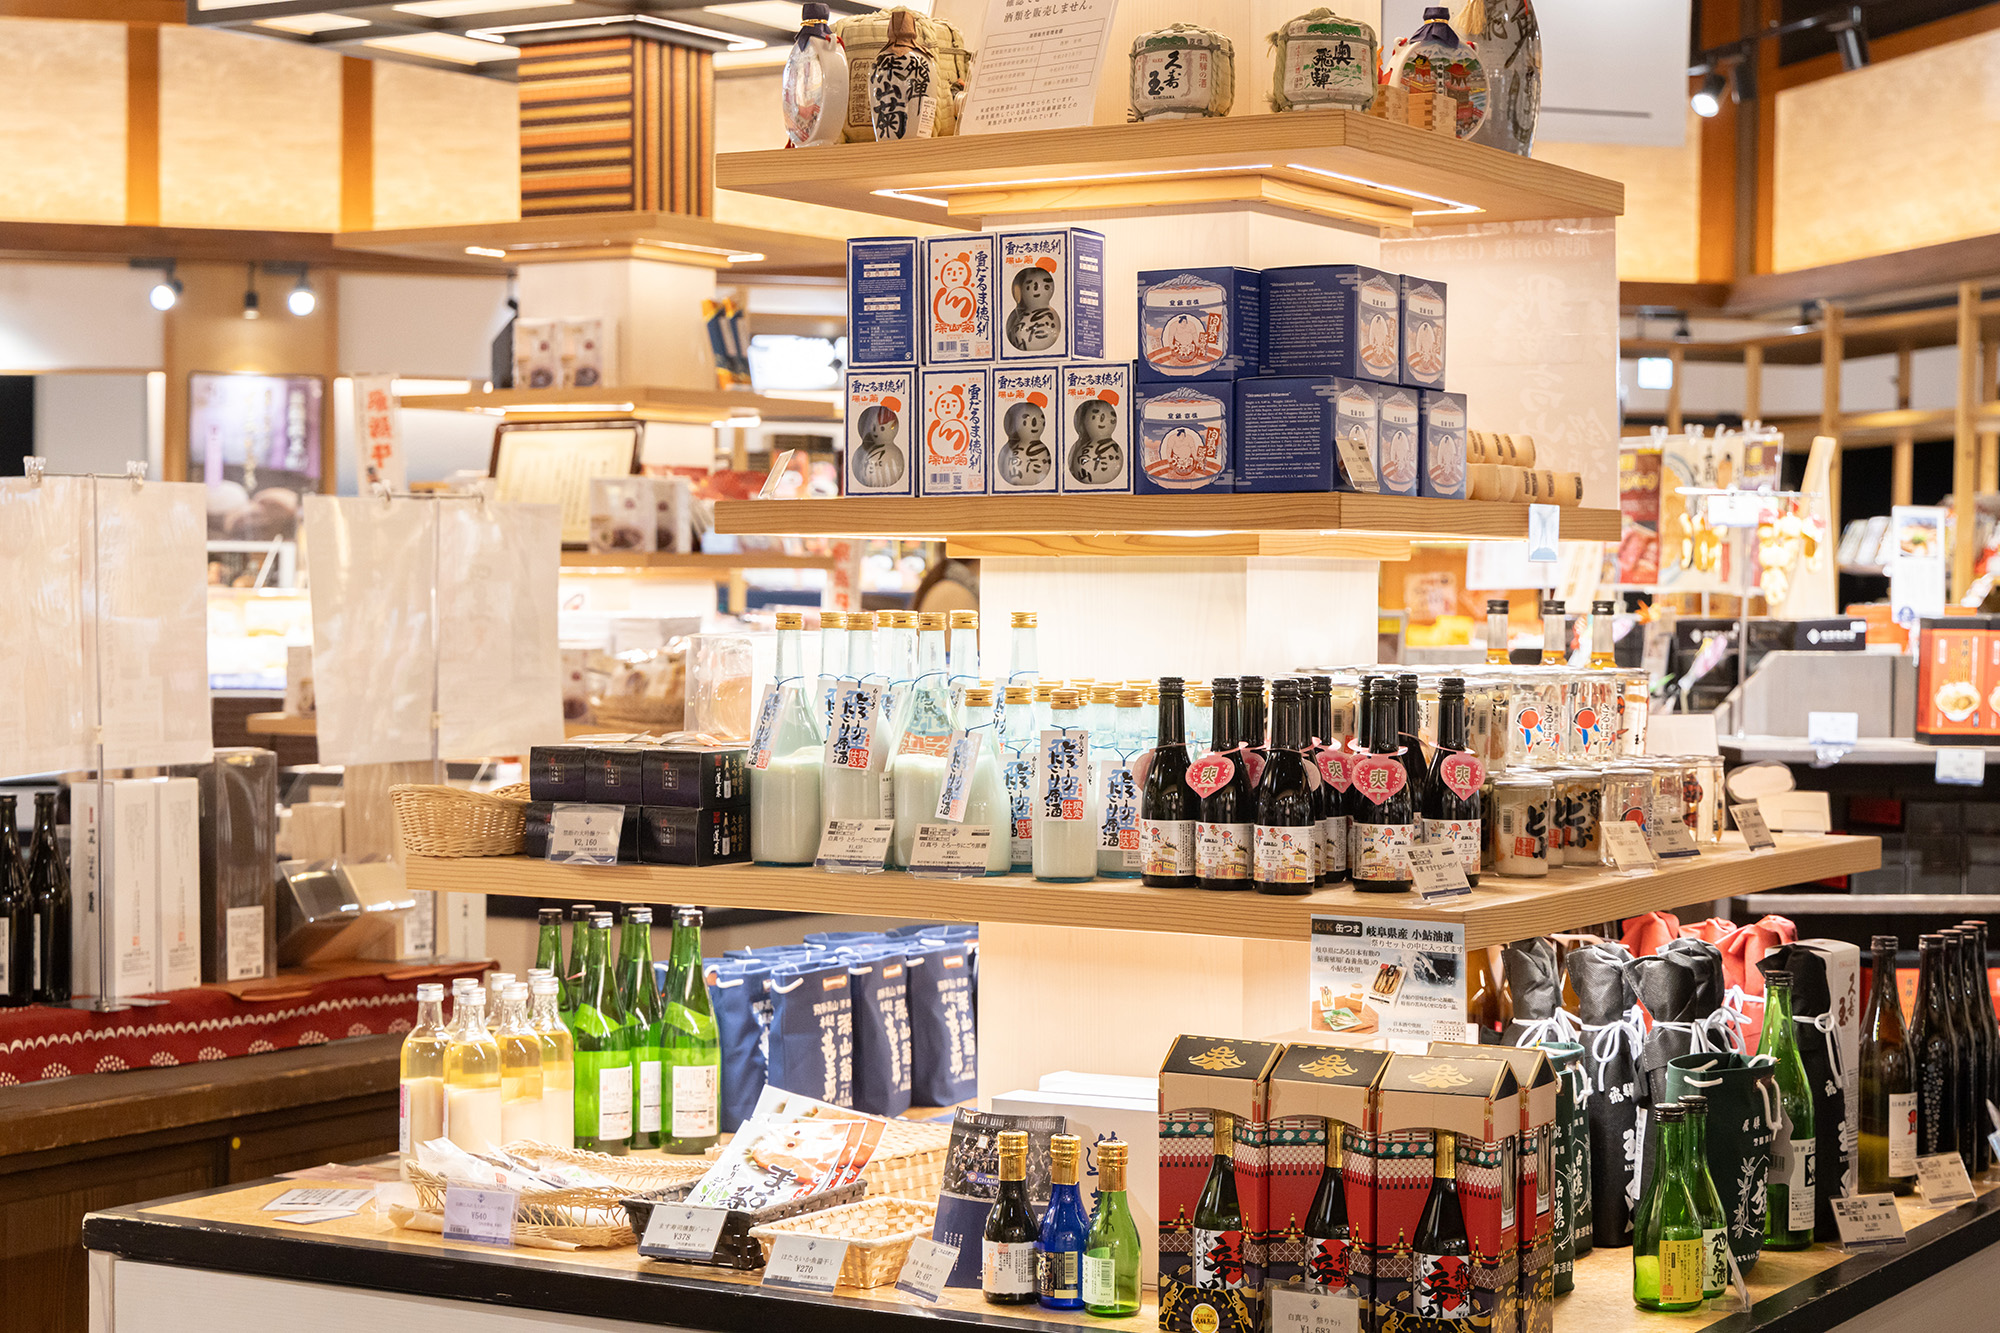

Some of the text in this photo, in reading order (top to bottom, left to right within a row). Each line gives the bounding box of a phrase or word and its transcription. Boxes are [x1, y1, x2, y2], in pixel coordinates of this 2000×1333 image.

[1004, 3, 1093, 23] 酒類を販売しません。
[1005, 239, 1061, 255] 雪だるま徳利
[974, 250, 990, 341] 雪だるま徳利
[851, 380, 905, 395] 雪だるま徳利
[997, 374, 1052, 390] 雪だるま徳利
[1067, 371, 1124, 389] 雪だるま徳利
[967, 383, 982, 474] 雪だるま徳利
[1201, 766, 1218, 783] 爽
[1328, 760, 1343, 777] 爽
[1456, 765, 1471, 784] 爽
[1369, 768, 1388, 788] 爽
[574, 838, 597, 847] ¥2,160
[1314, 921, 1334, 932] K&K
[1335, 923, 1360, 934] 缶つま
[1366, 926, 1454, 943] 岐阜県産 小鮎油漬
[1315, 946, 1380, 957] 岐阜県にある日本有数の
[1371, 939, 1464, 954] 祭りセットの中に入ってます
[471, 1211, 487, 1220] ¥540
[673, 1233, 691, 1241] ¥378
[796, 1264, 814, 1274] ¥270
[1288, 1313, 1308, 1323] 白真弓
